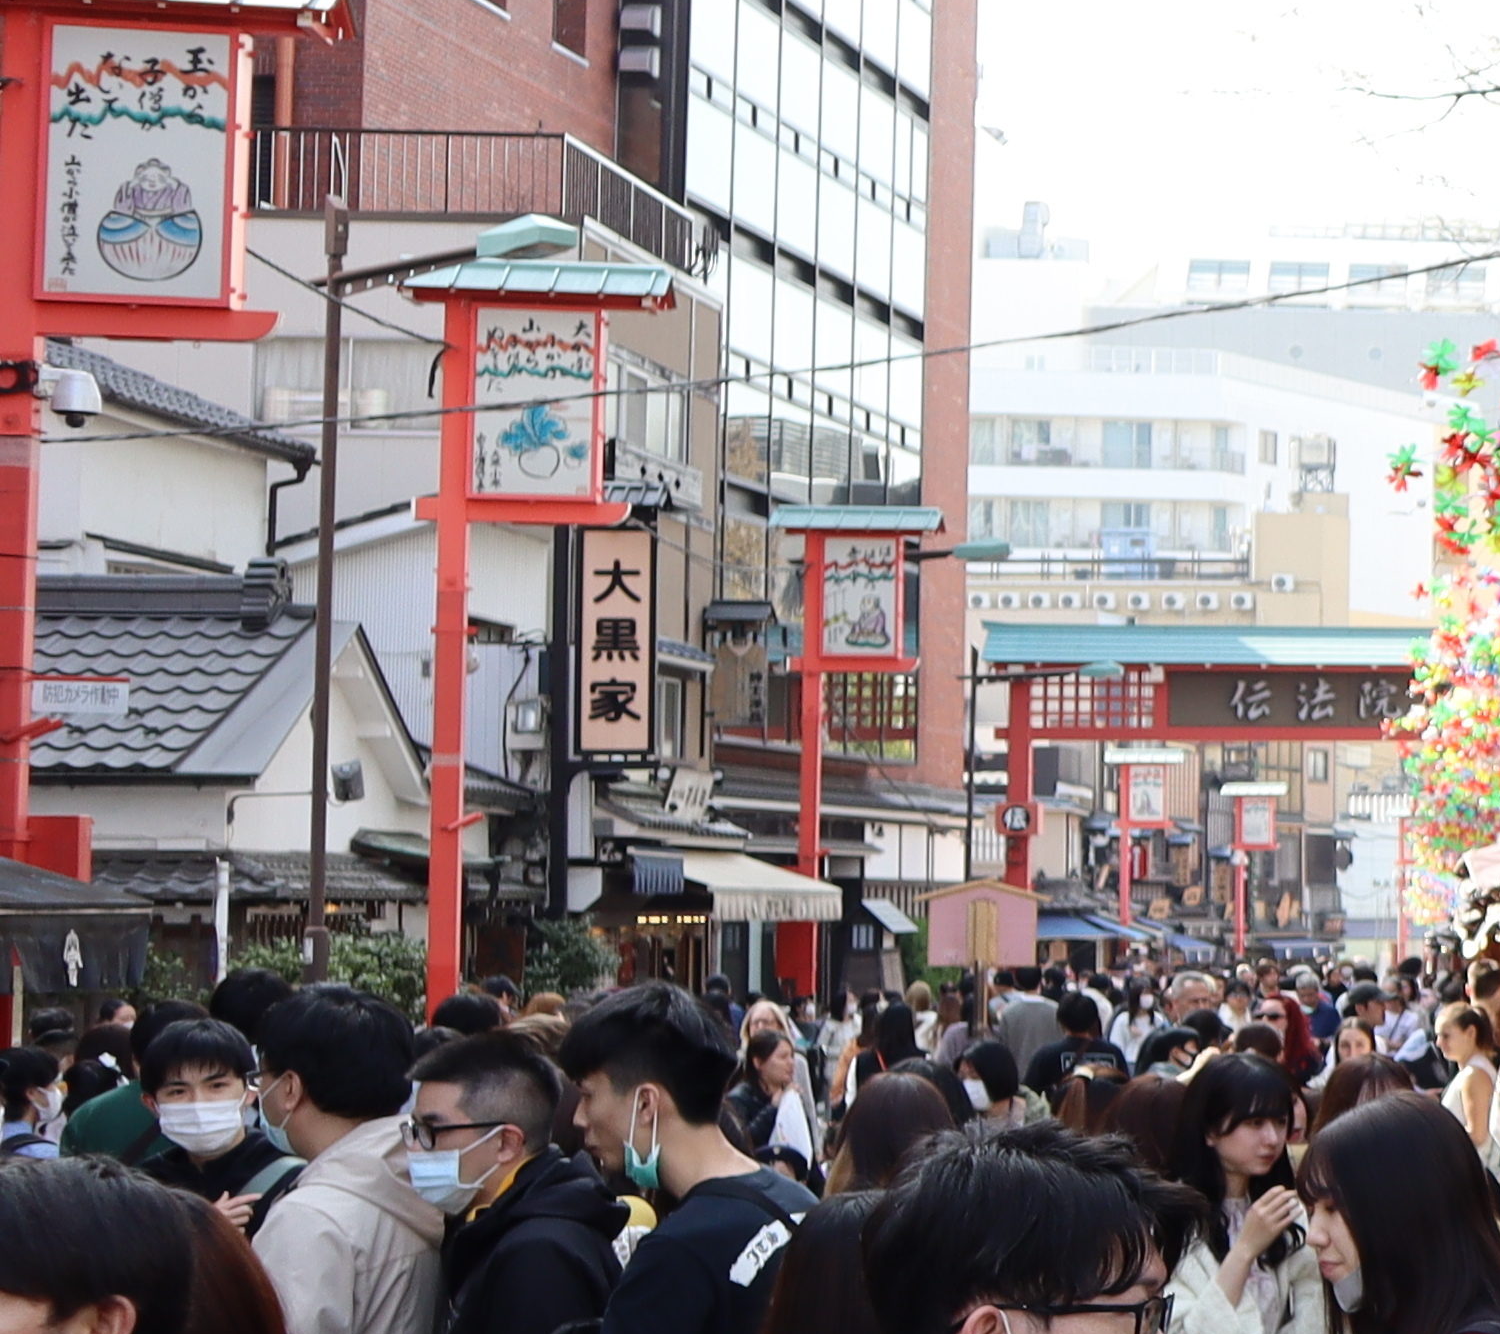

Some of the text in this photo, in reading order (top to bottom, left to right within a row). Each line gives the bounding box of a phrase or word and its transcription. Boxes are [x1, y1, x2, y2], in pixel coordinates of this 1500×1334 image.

[588, 558, 641, 724] 大黒家
[1229, 676, 1415, 721] 伝法院
